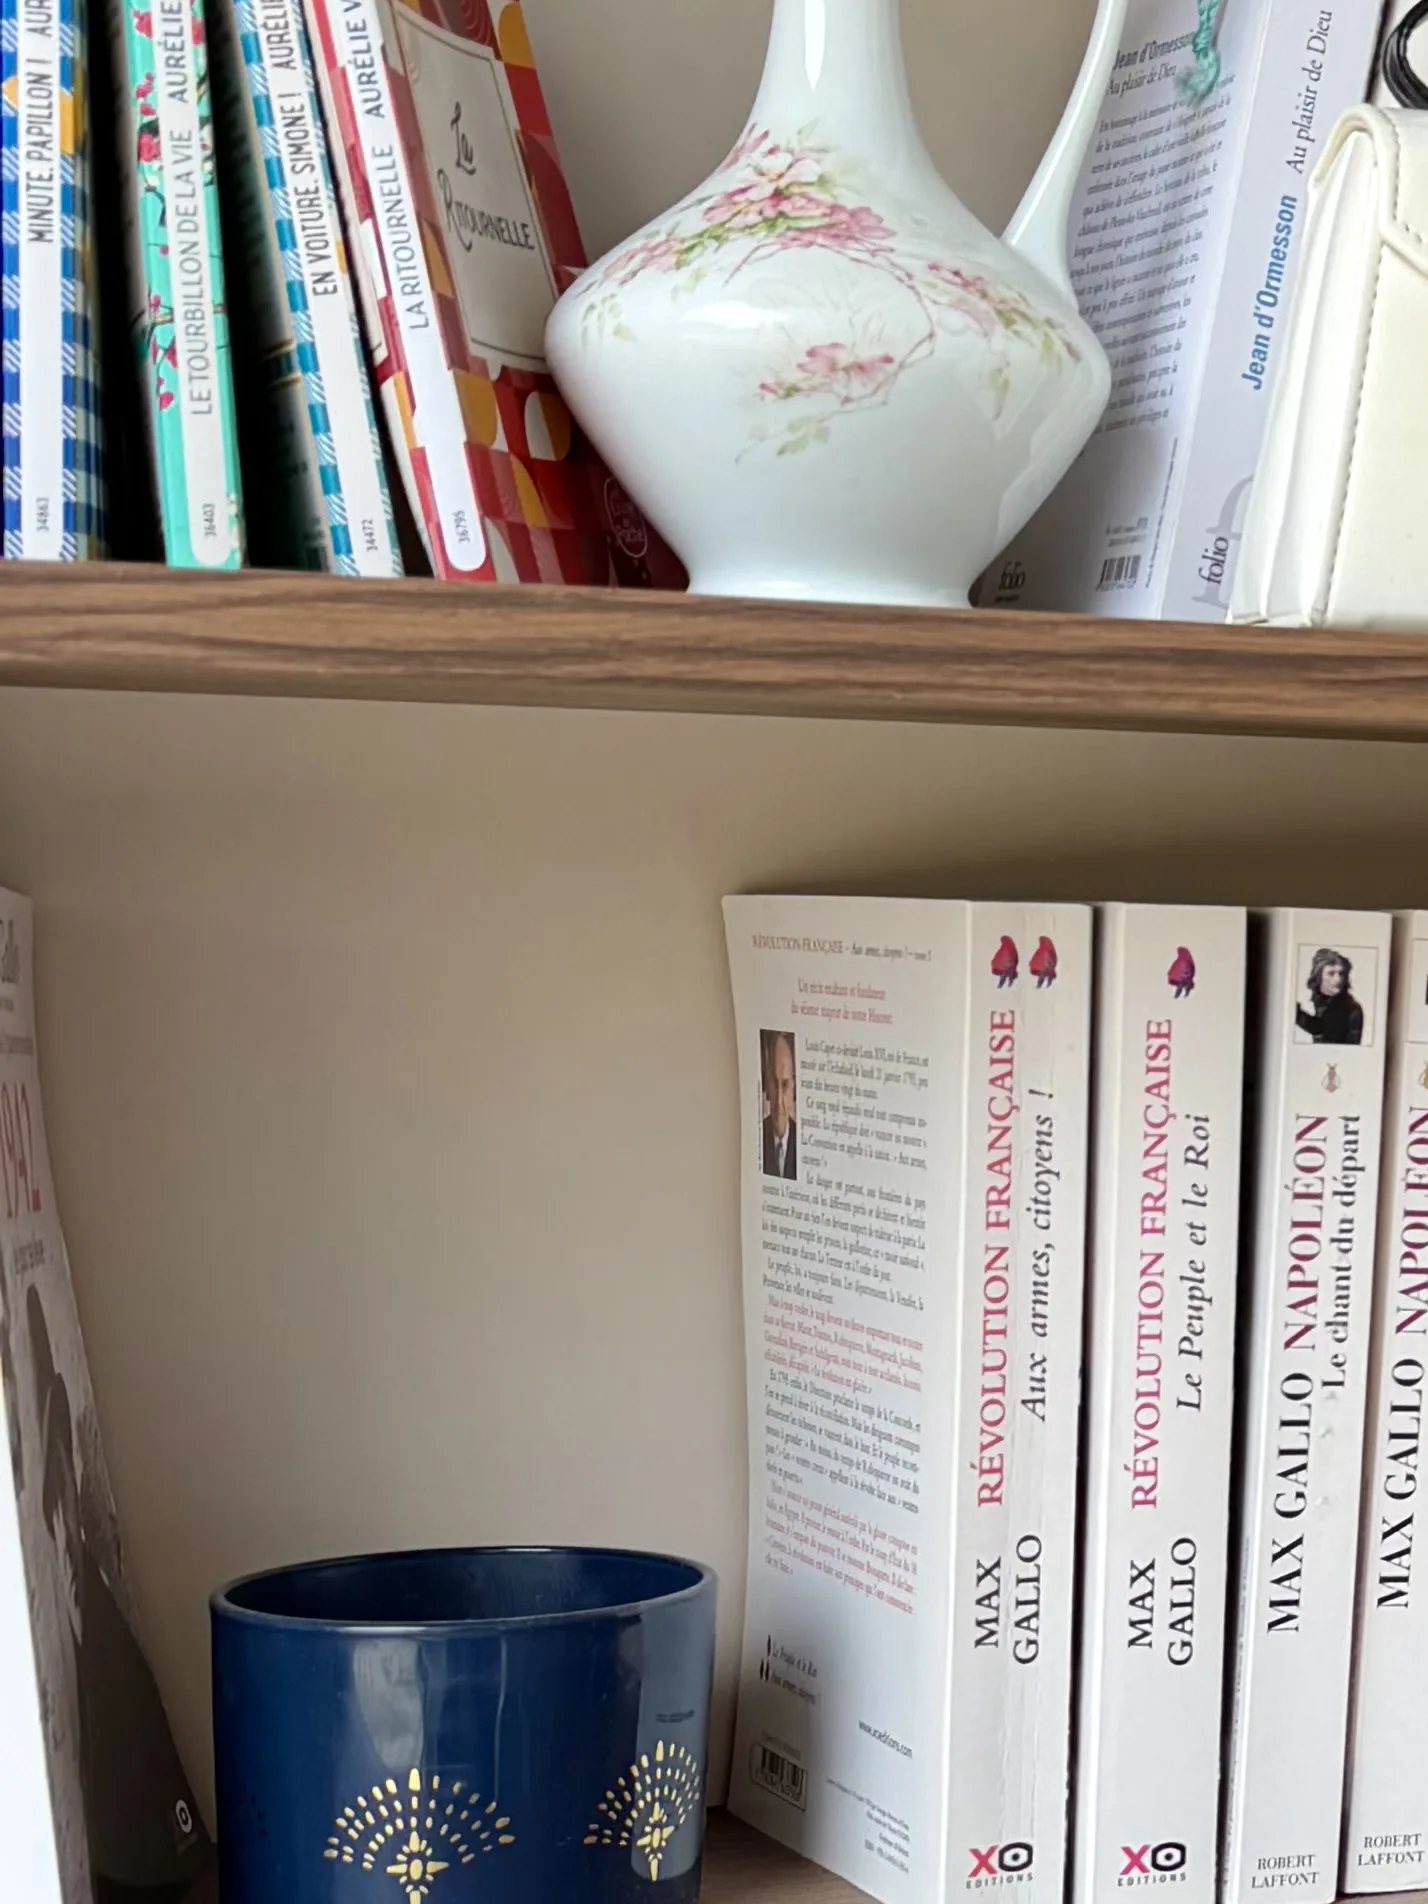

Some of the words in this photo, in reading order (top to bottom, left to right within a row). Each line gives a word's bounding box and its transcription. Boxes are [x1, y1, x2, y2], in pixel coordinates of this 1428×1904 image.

[157, 1, 188, 103] AURÉLIE
[345, 18, 385, 118] AURÉLIE
[1301, 59, 1323, 82] de
[1306, 10, 1332, 55] Dieu
[170, 130, 192, 164] VIE
[1291, 85, 1318, 143] plaisir
[174, 171, 196, 198] LA
[1285, 146, 1307, 174] Au
[175, 205, 198, 233] DE
[379, 144, 423, 296] RITOURNELLE
[1252, 195, 1297, 328] d'Ormesson
[179, 241, 209, 383] TOURBILLON
[405, 300, 429, 329] LA
[189, 389, 212, 415] LE
[1241, 333, 1270, 390] Jean
[1198, 536, 1228, 584] folio
[985, 1009, 1020, 1230] FRANÇAISE
[1141, 1019, 1177, 1235] FRANÇAISE
[1183, 1114, 1209, 1169] Roi
[1332, 1115, 1365, 1207] départ
[1025, 1114, 1060, 1230] citoyens
[1181, 1183, 1208, 1207] le
[1186, 1221, 1207, 1246] et
[1283, 1114, 1328, 1350] NAPOLÉON
[1329, 1218, 1354, 1254] du
[1031, 1243, 1054, 1338] armes,
[1177, 1259, 1213, 1359] Peuple
[1324, 1265, 1352, 1343] chant
[967, 1243, 1011, 1509] RÉVOLUTION
[1020, 1352, 1047, 1422] Aux
[1123, 1250, 1164, 1509] RÉVOLUTION
[1176, 1373, 1202, 1411] Le
[1321, 1353, 1346, 1387] Le
[1274, 1372, 1312, 1518] GALLO
[1384, 1358, 1423, 1500] GALLO
[974, 1556, 1001, 1648] MAX
[1013, 1534, 1042, 1664] GALLO
[1127, 1558, 1155, 1648] MAX
[1167, 1537, 1196, 1665] GALLO
[1267, 1535, 1304, 1631] MAX
[1376, 1514, 1413, 1607] MAX
[1251, 1871, 1317, 1888] LAFFONT
[1257, 1854, 1314, 1870] ROBERT
